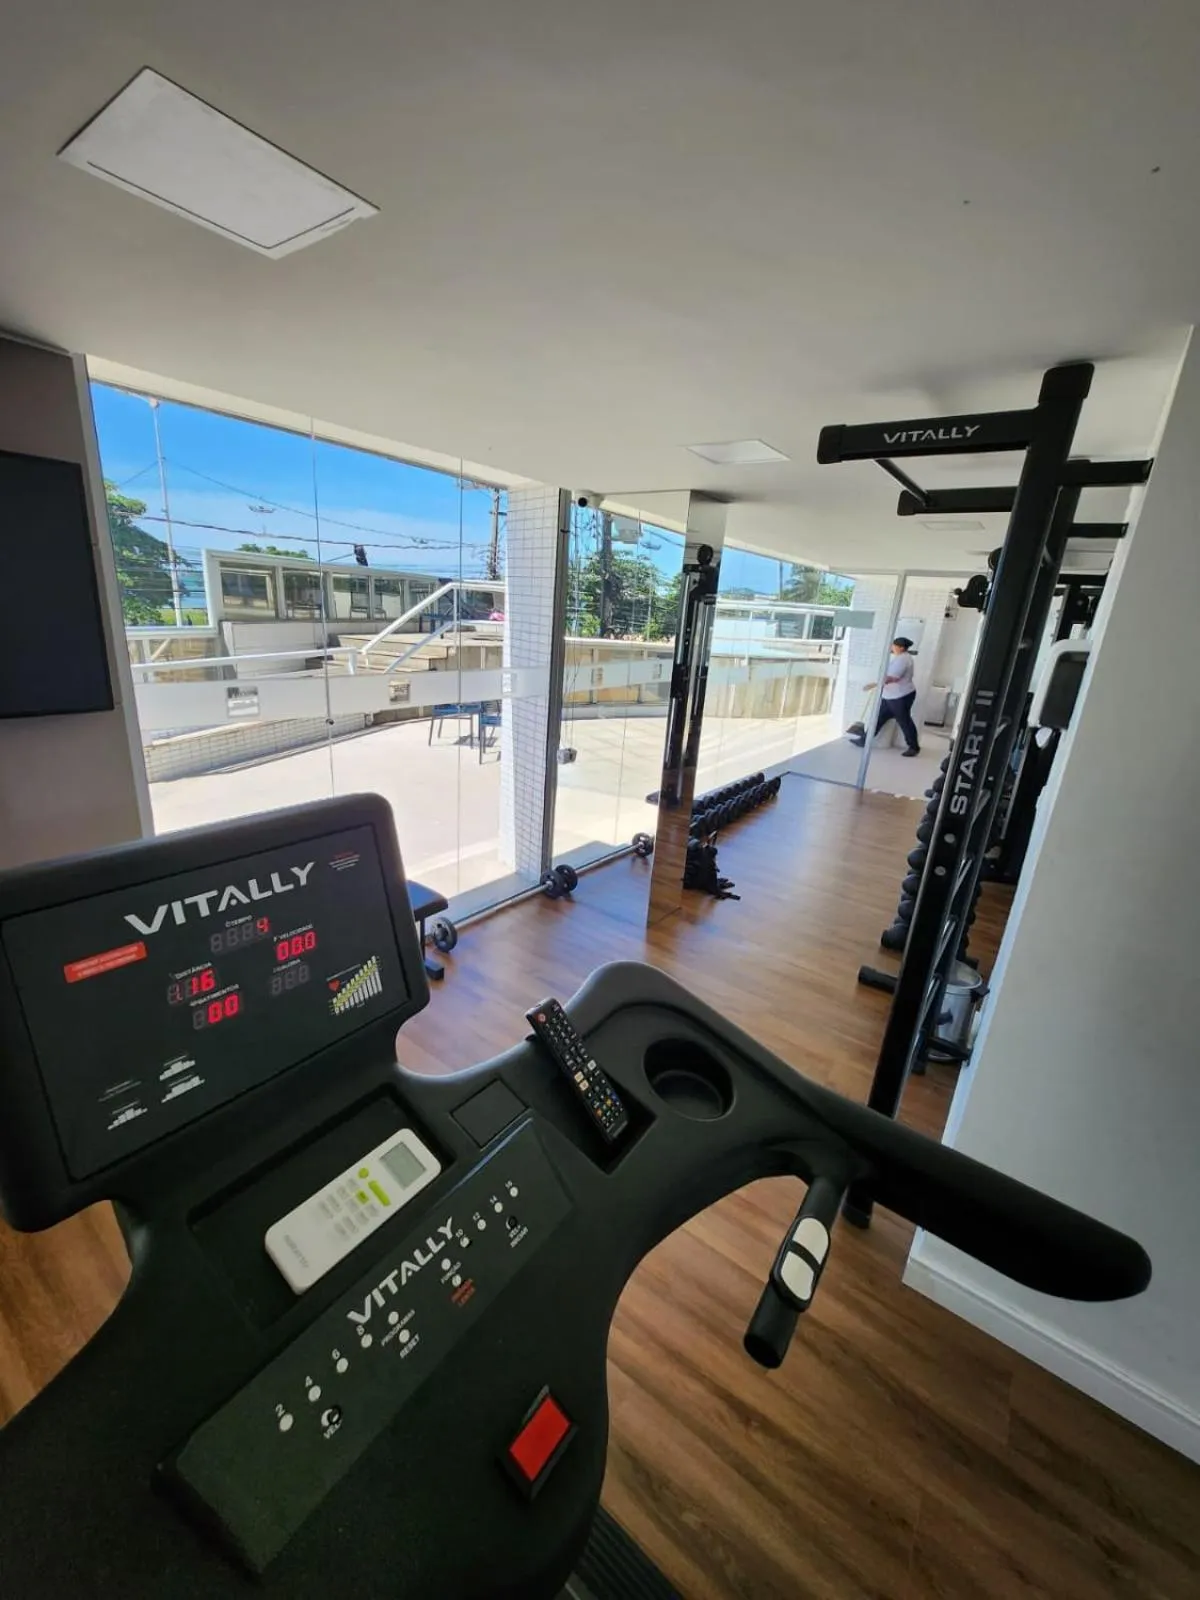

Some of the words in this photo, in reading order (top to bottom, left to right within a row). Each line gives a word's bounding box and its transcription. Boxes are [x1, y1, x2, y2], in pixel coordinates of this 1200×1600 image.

[883, 424, 980, 444] VITALLY
[949, 713, 987, 815] START
[123, 861, 315, 936] VITALLY
[455, 1228, 464, 1238] 10
[346, 1216, 453, 1324] VITALLY
[356, 1324, 365, 1336] 8
[331, 1348, 341, 1360] 6
[400, 1333, 420, 1359] RESET
[304, 1375, 313, 1388] 4
[275, 1403, 286, 1418] 2
